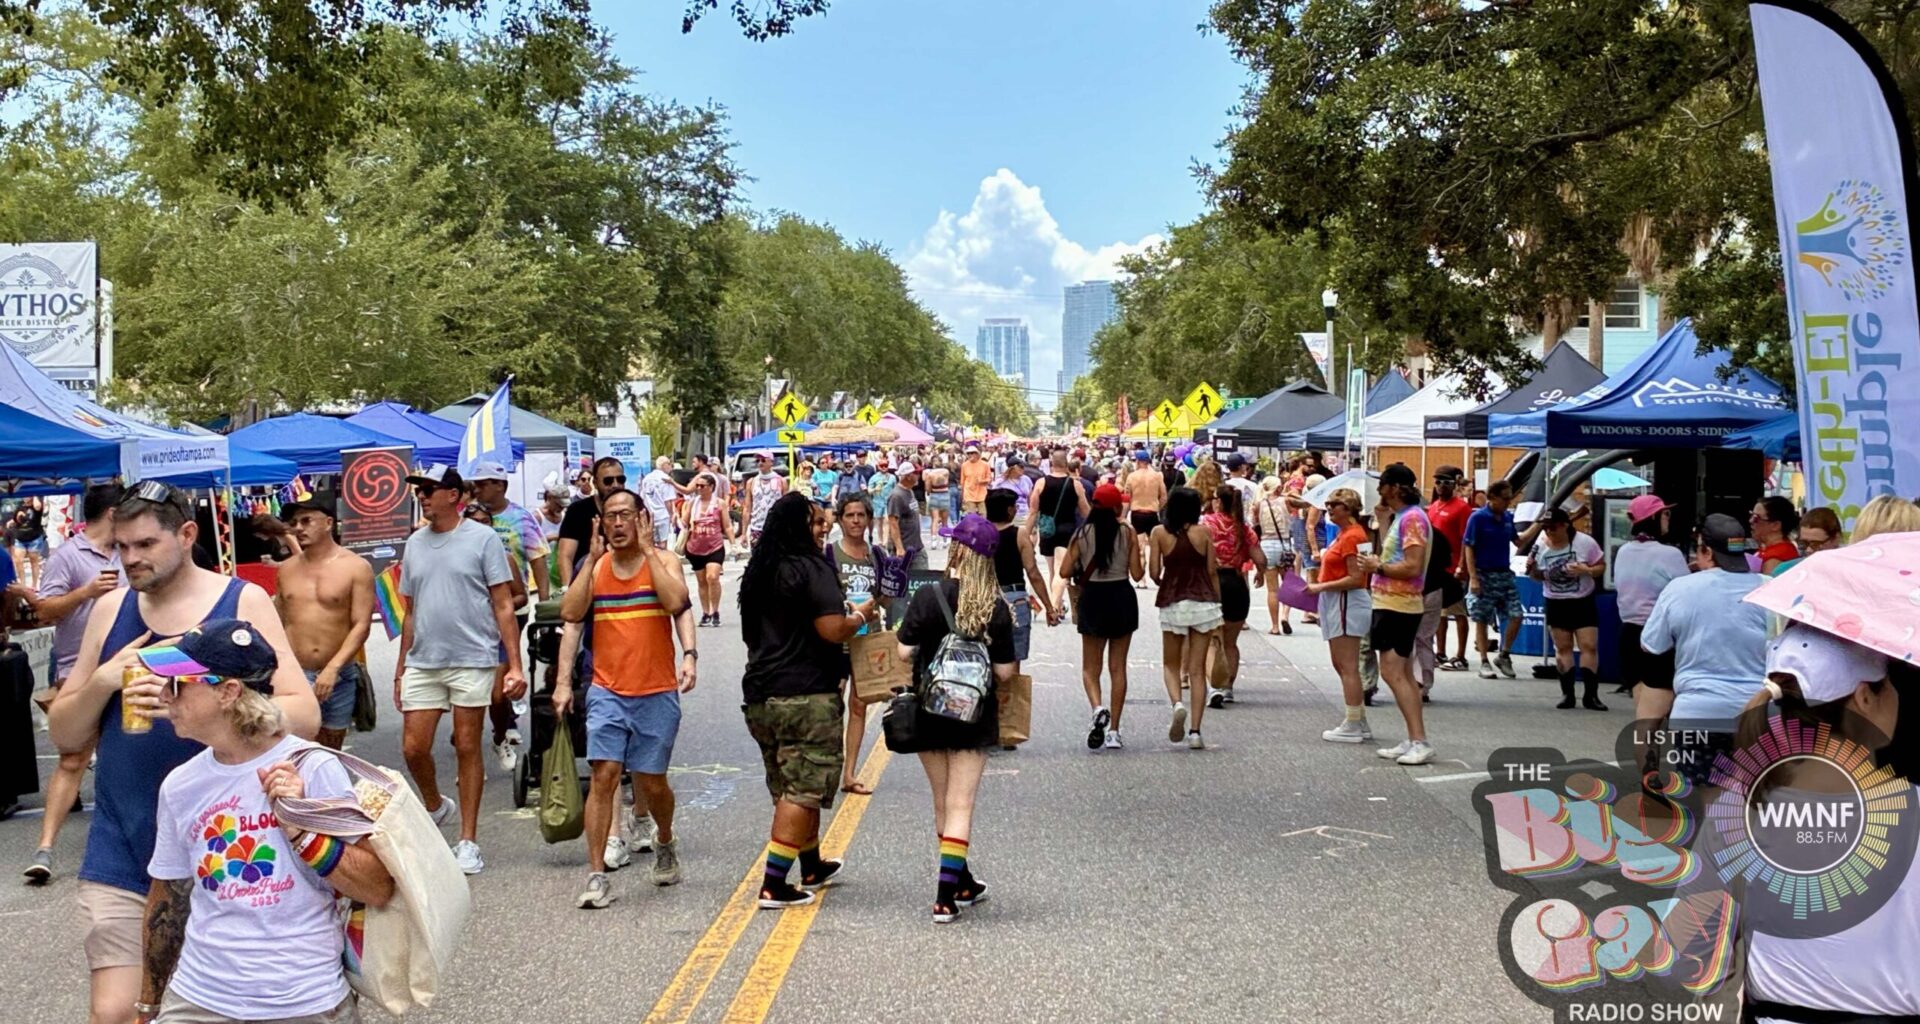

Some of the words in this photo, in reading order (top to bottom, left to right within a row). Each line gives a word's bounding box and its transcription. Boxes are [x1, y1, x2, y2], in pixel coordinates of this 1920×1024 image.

[0, 292, 85, 317] YTHOS
[1581, 425, 1642, 436] WINDOWS
[1648, 426, 1692, 436] DOORS
[141, 446, 216, 467] www.prideoftampa.com
